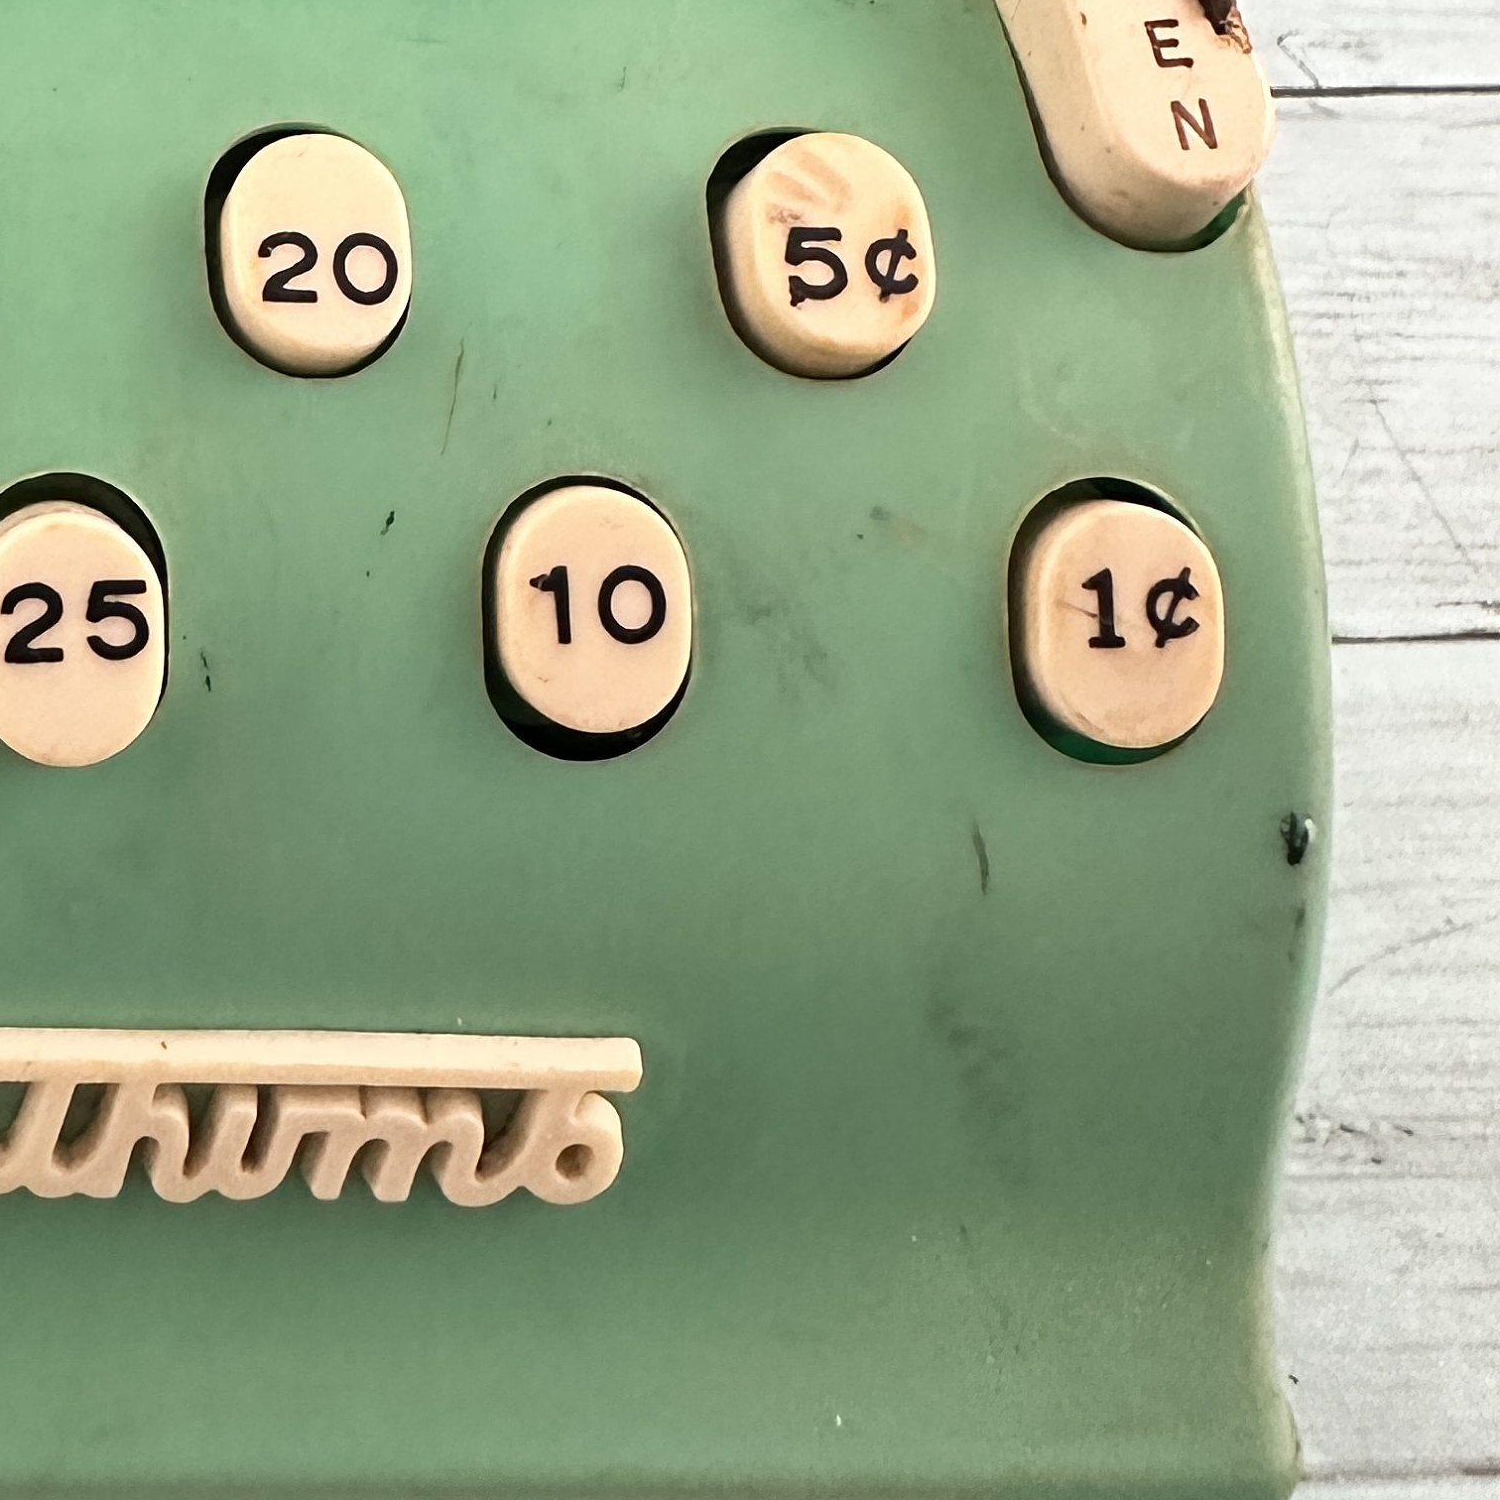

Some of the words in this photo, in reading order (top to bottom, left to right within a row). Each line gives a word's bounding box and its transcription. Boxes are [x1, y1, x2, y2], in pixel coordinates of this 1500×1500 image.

[256, 230, 399, 306] 20
[783, 226, 919, 308] 5¢
[0, 578, 150, 664] 25
[528, 564, 667, 646] 10
[1080, 566, 1201, 649] 1¢
